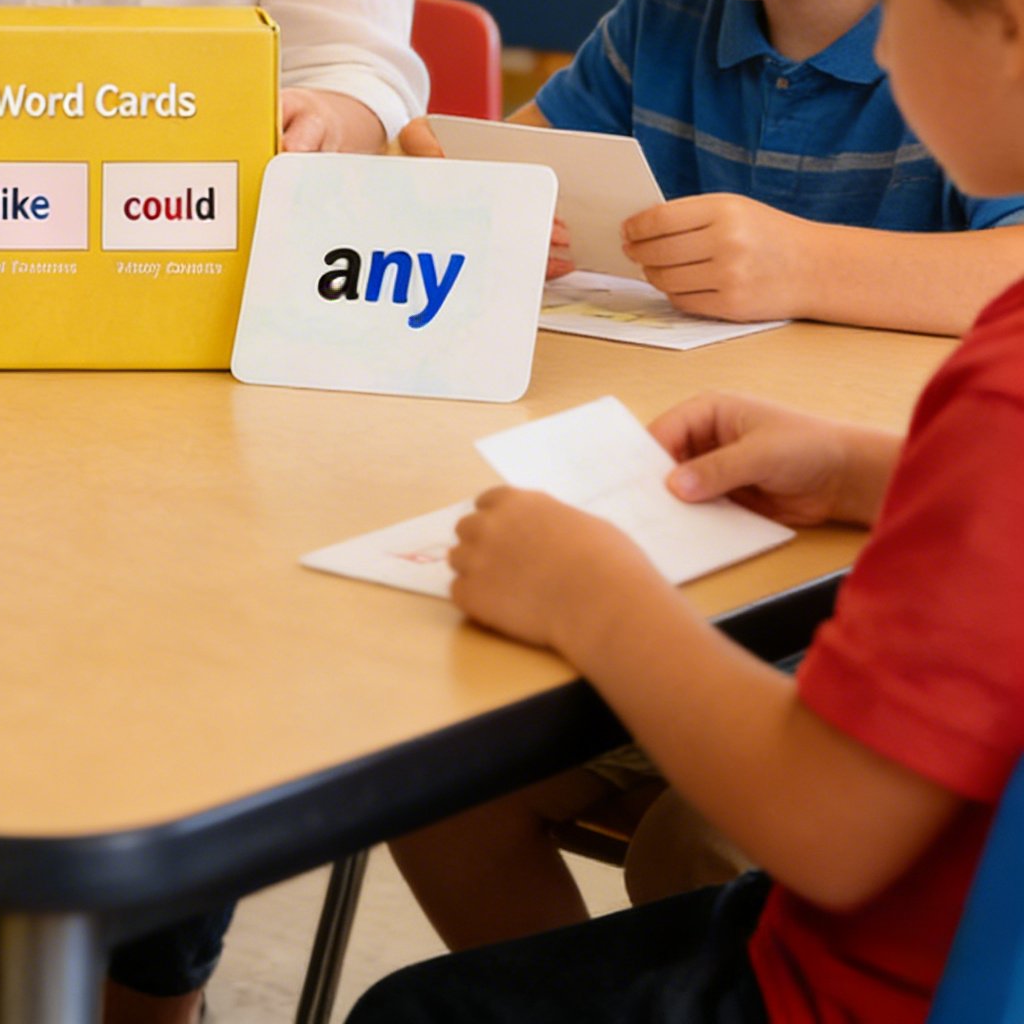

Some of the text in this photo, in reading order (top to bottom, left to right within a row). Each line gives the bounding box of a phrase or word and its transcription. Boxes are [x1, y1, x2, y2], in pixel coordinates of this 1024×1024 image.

[95, 83, 197, 118] Cards
[124, 187, 216, 221] could
[317, 247, 466, 329] any
